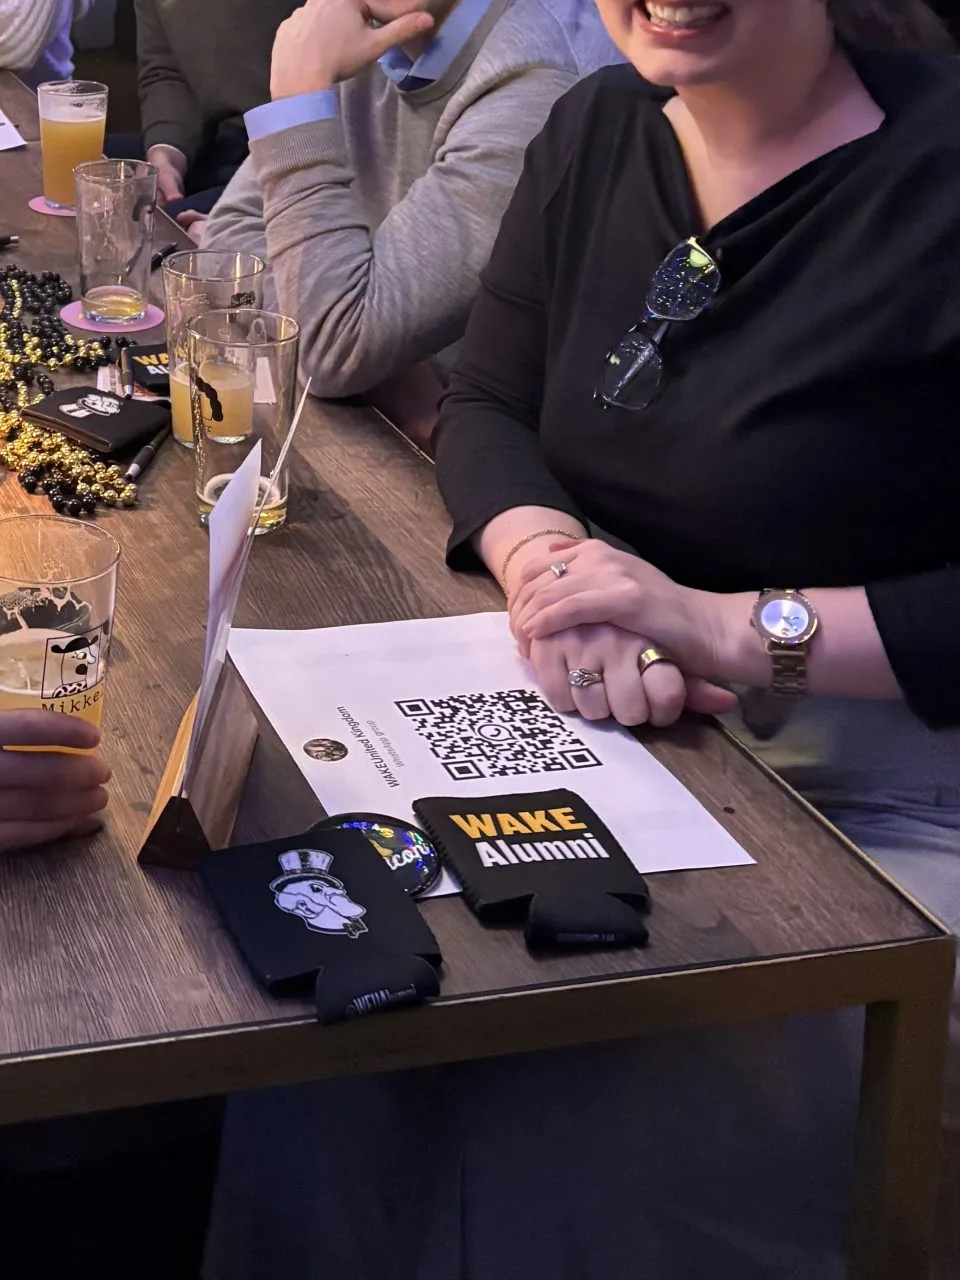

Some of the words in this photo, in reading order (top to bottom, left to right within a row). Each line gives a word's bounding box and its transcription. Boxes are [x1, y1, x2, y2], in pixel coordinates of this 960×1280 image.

[337, 706, 366, 740] Kingdom
[366, 719, 385, 738] group
[449, 807, 587, 839] WAKE
[474, 832, 610, 868] Alumni
